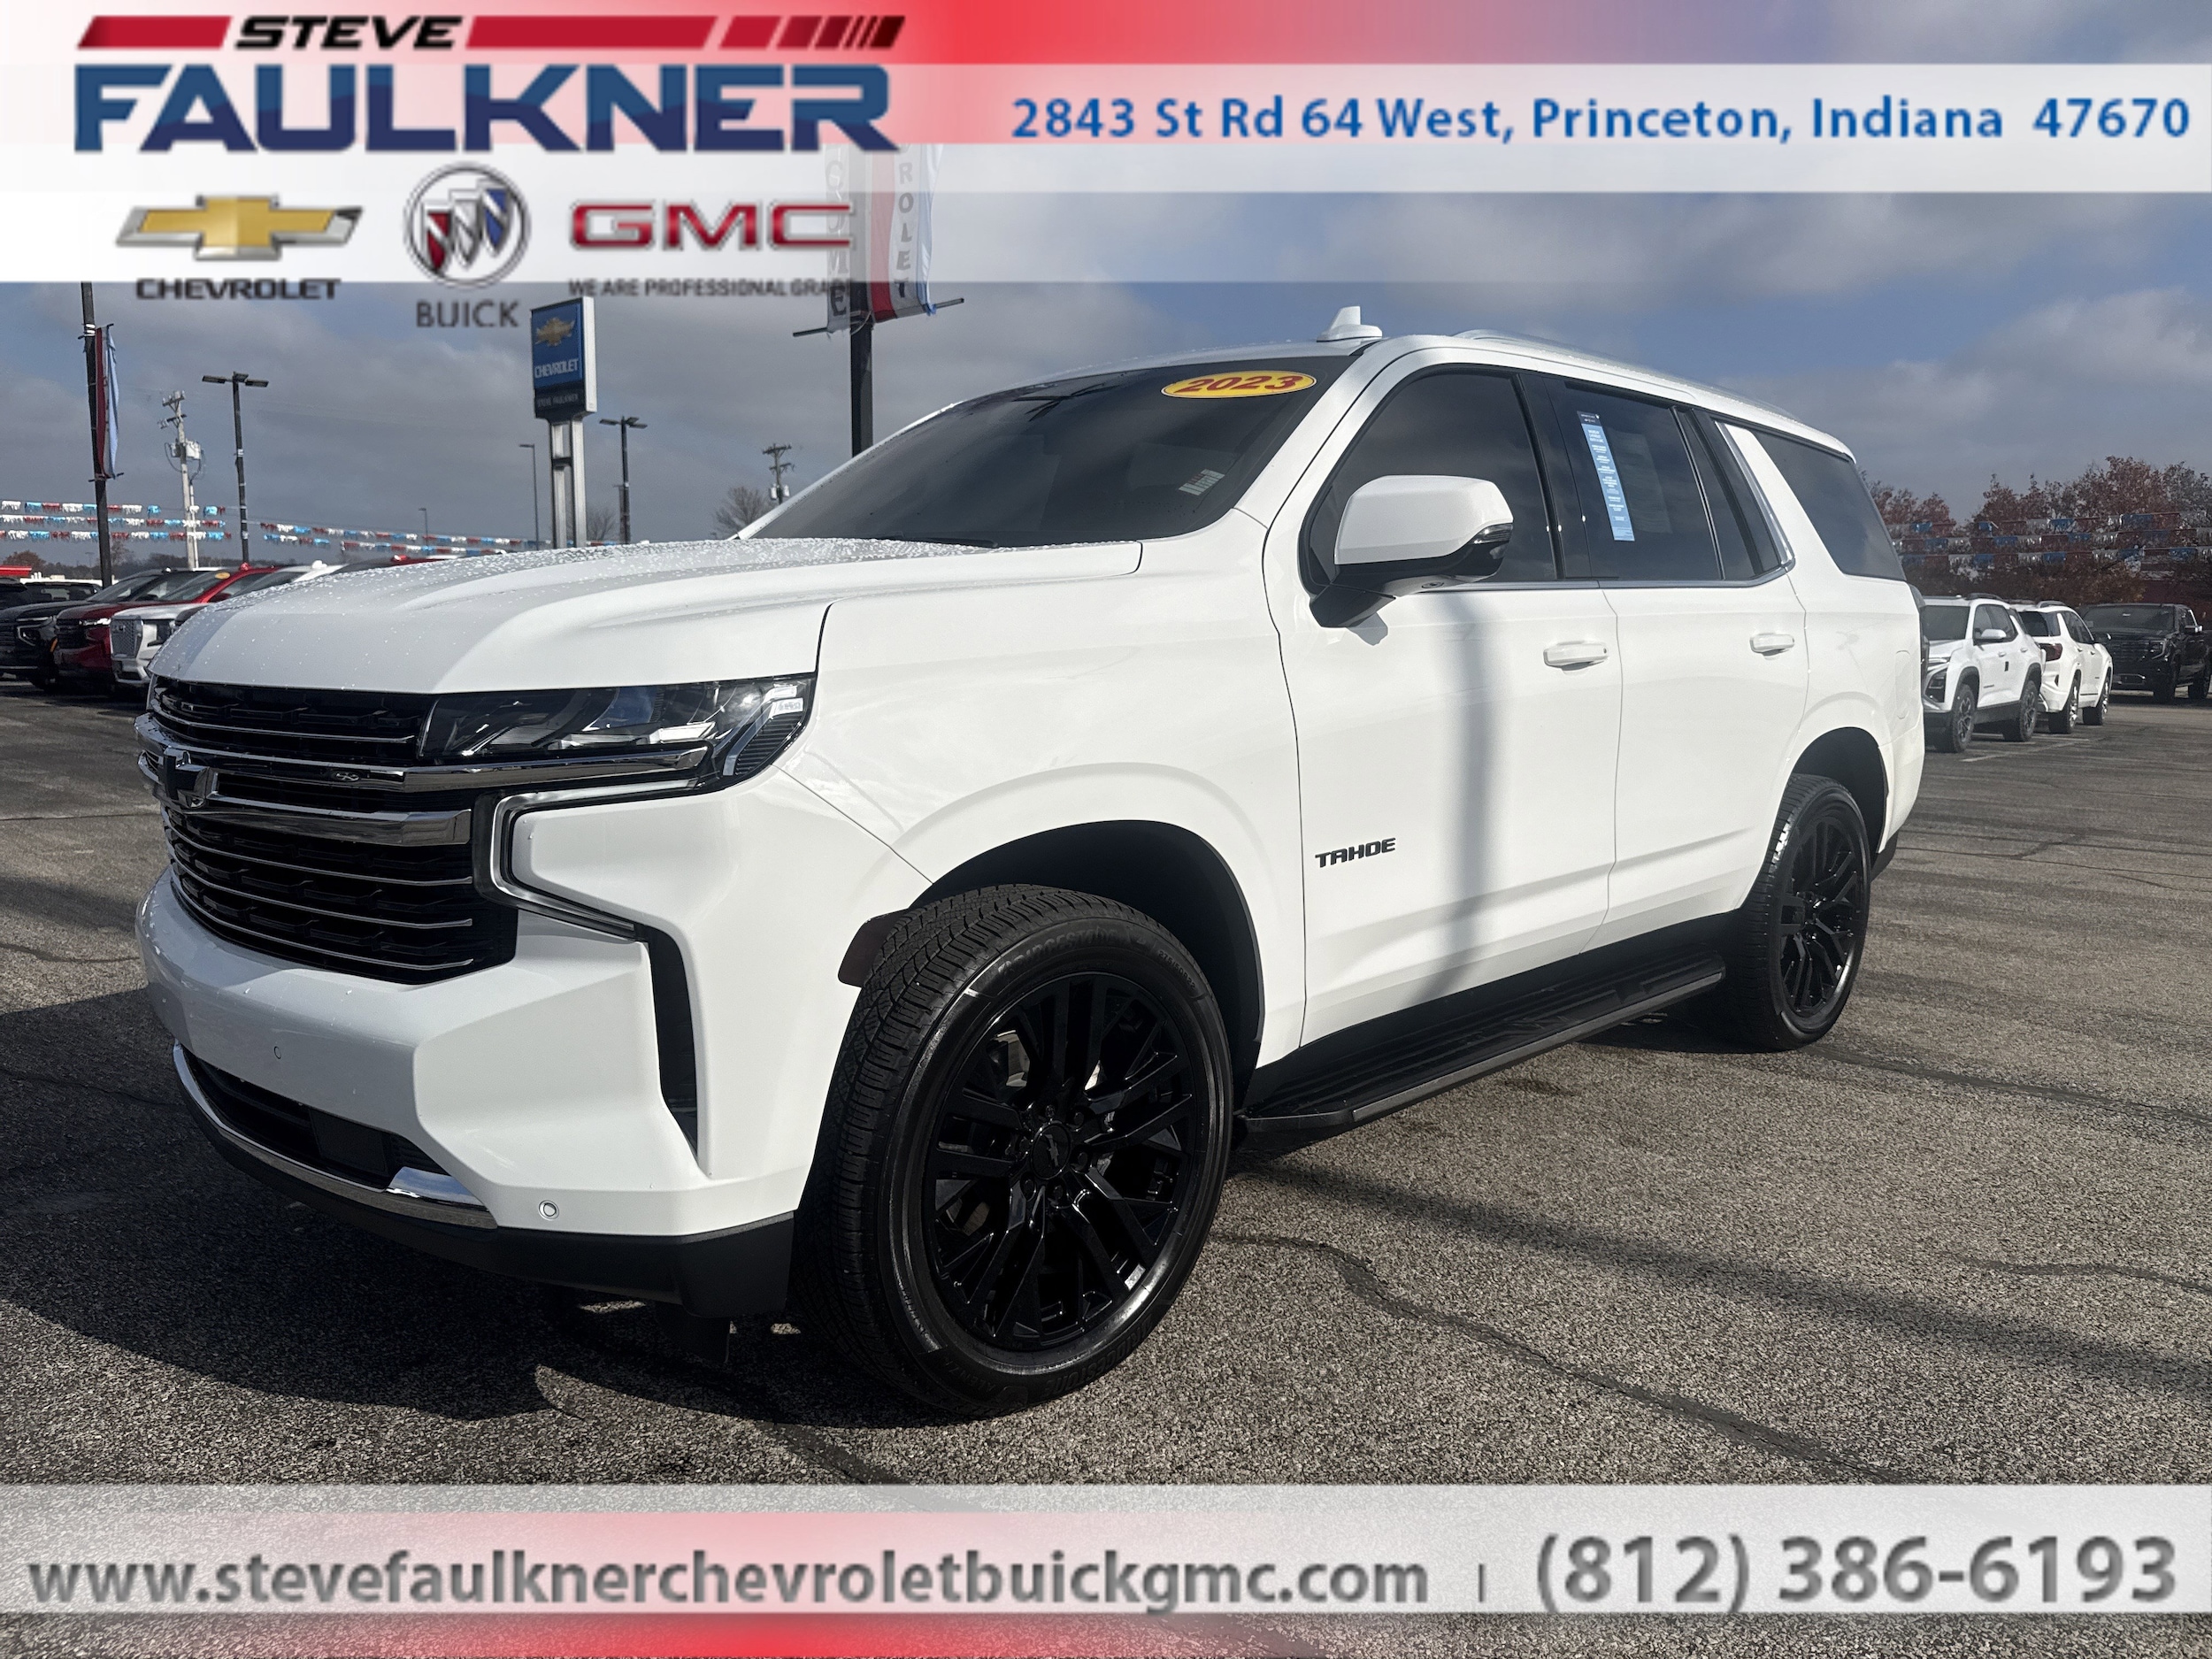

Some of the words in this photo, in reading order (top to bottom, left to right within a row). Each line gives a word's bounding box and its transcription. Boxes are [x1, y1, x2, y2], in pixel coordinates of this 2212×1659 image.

[534, 357, 579, 379] CHEVROLET
[1173, 375, 1304, 394] 2023
[1315, 837, 1396, 868] TAHOE
